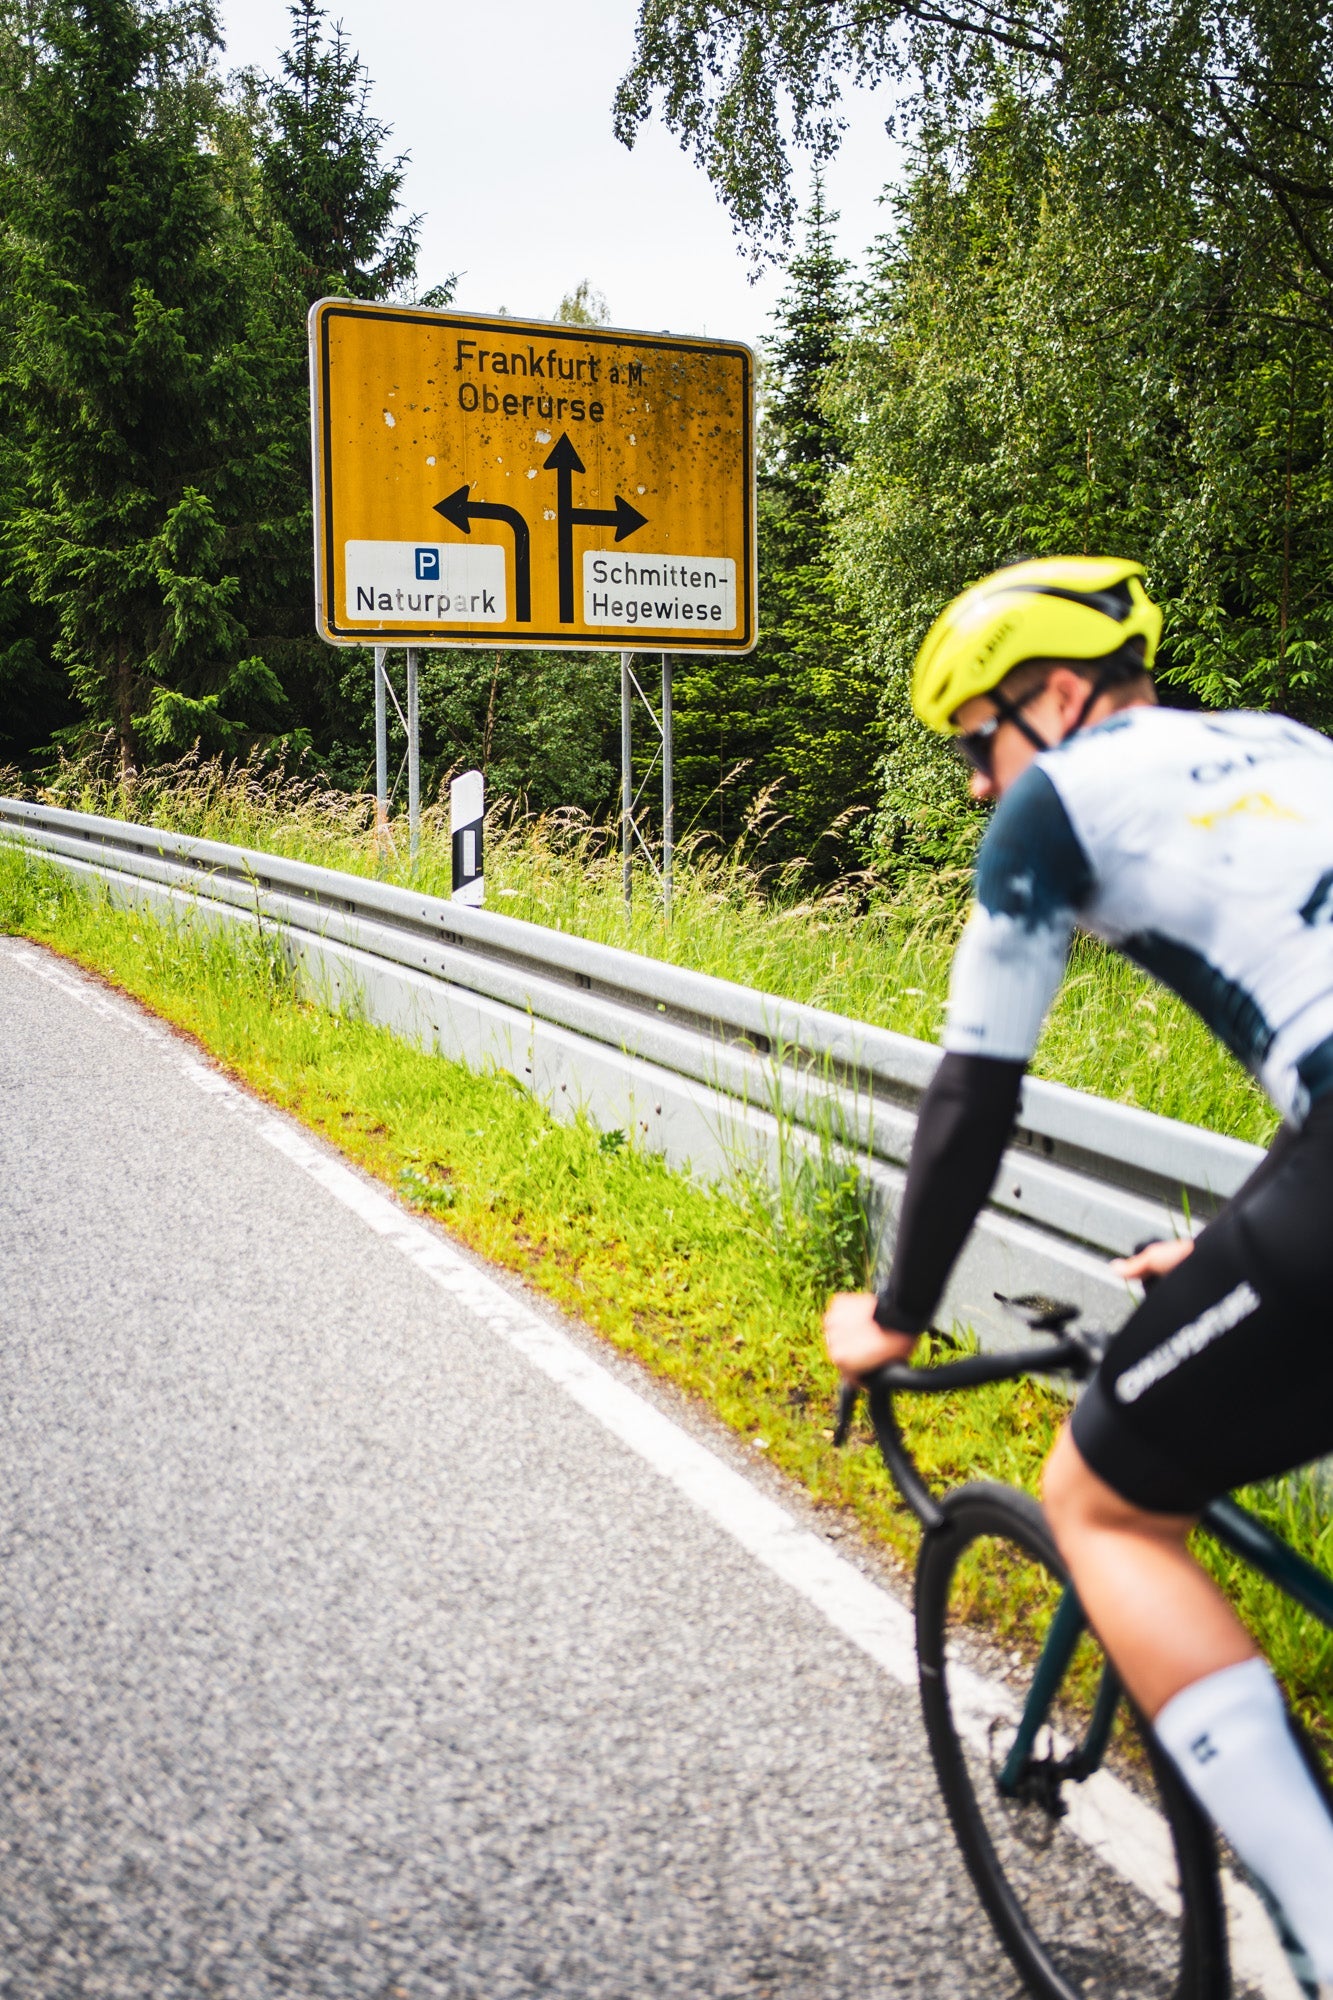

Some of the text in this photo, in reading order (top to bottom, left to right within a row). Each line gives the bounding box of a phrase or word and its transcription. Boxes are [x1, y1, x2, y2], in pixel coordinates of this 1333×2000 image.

[456, 339, 599, 383] Frankfurt
[419, 552, 437, 578] P
[593, 560, 728, 588] Schmitten-
[357, 586, 496, 618] Naturpark
[593, 593, 722, 623] Hegewiese
